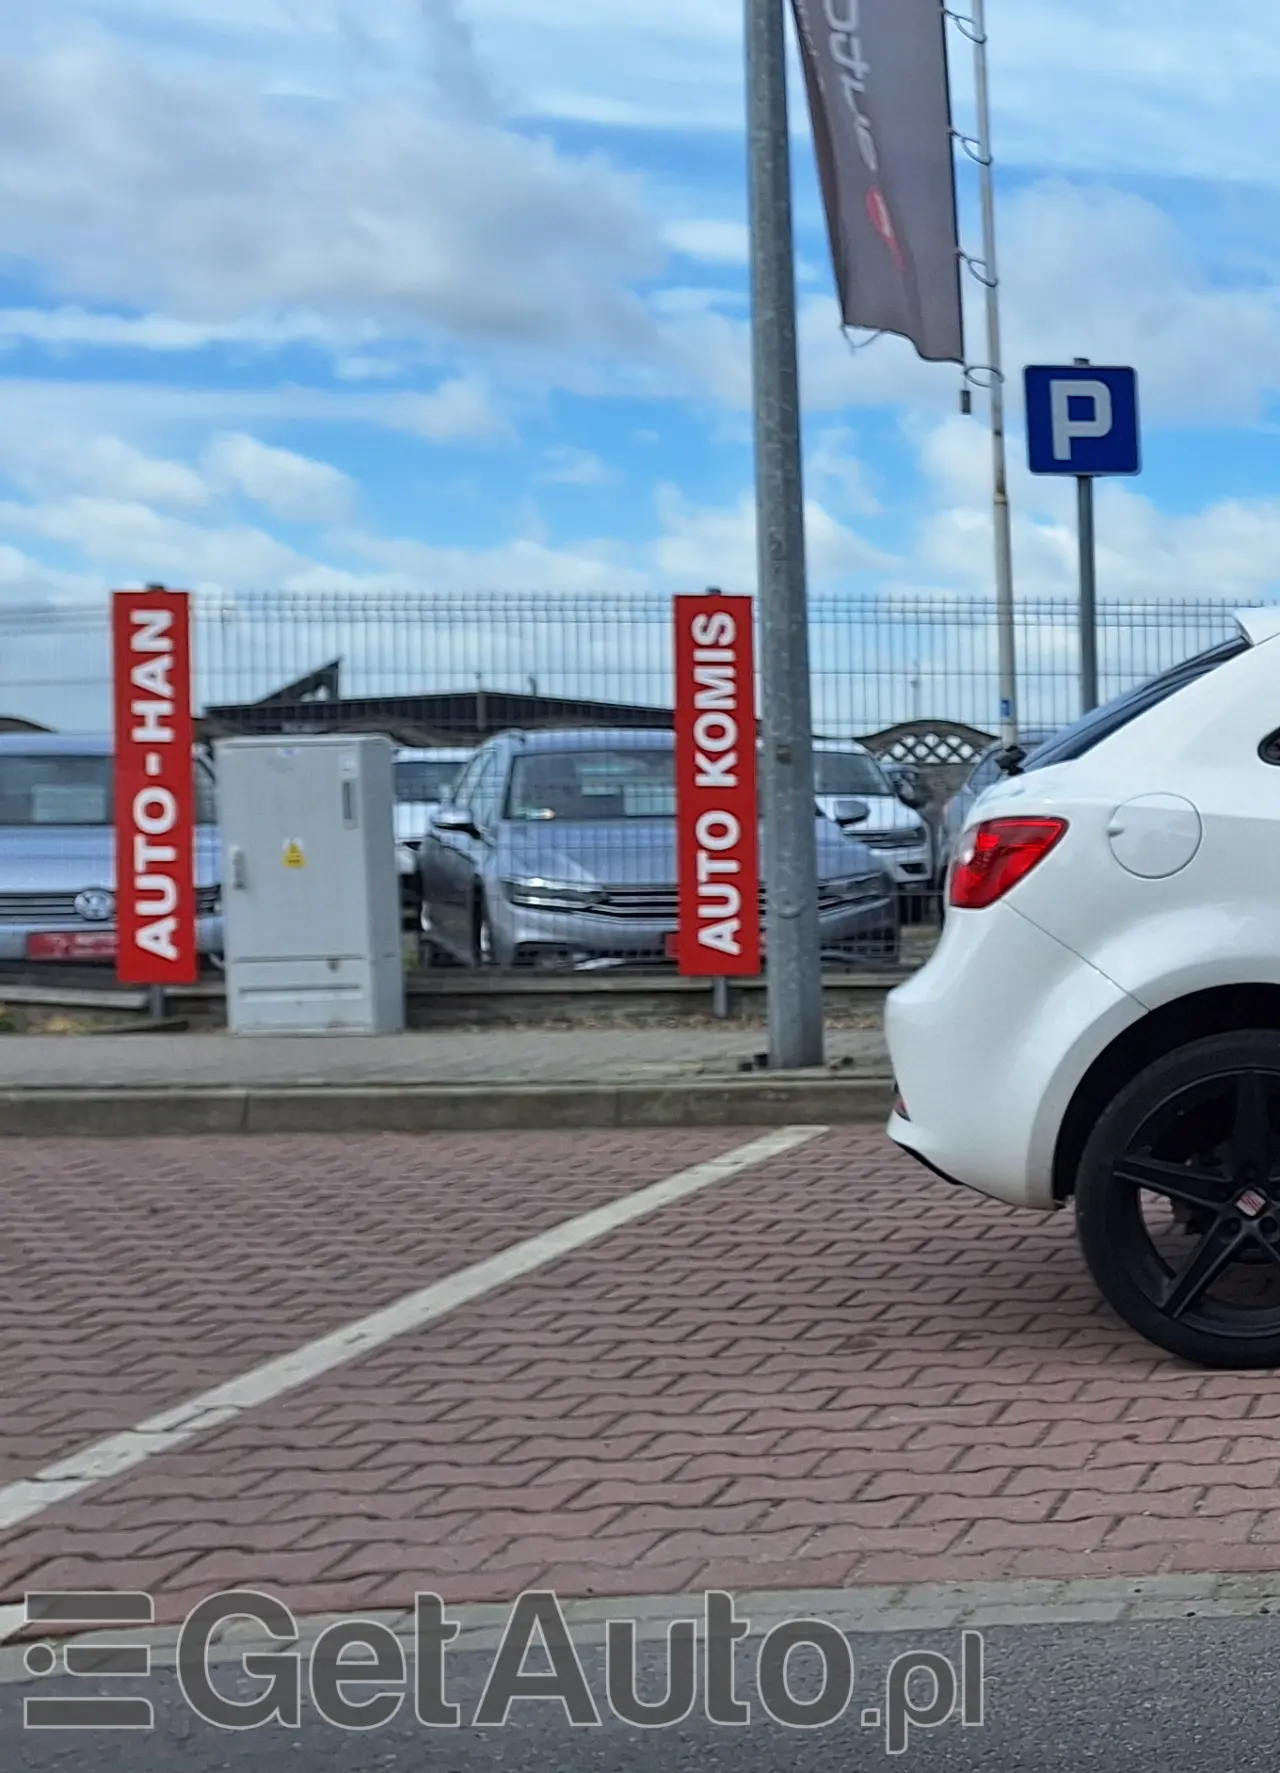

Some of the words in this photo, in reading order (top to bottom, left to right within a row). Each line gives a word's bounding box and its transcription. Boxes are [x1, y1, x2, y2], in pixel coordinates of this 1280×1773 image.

[1049, 379, 1113, 461] P
[692, 611, 738, 788] KOMIS
[694, 810, 741, 956] AUTO
